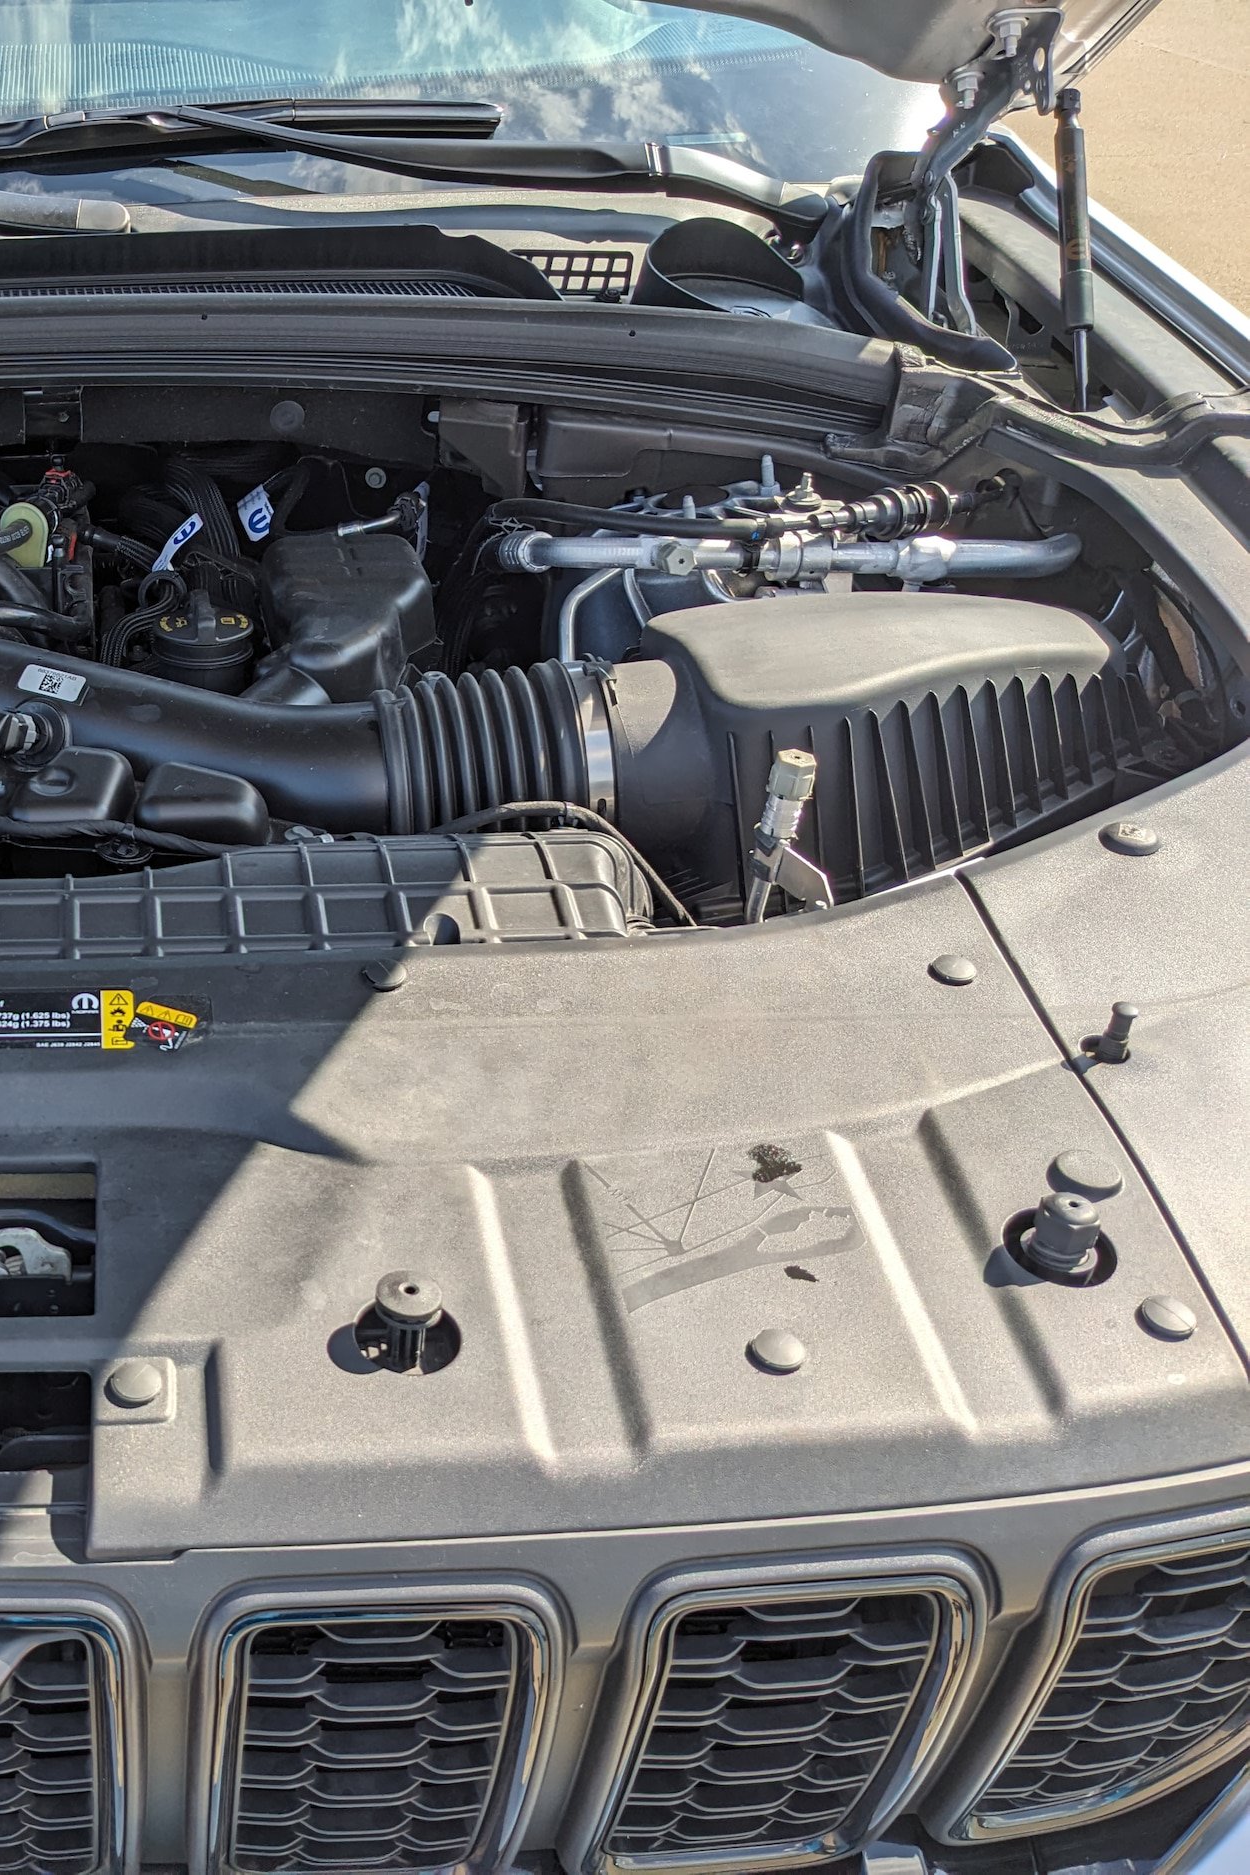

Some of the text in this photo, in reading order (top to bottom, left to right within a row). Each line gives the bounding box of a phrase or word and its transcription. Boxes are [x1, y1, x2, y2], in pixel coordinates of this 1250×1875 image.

[21, 1012, 50, 1020] (1.625
[51, 1012, 70, 1020] lbs)
[21, 1020, 50, 1028] (1.375
[51, 1020, 70, 1028] lbs)
